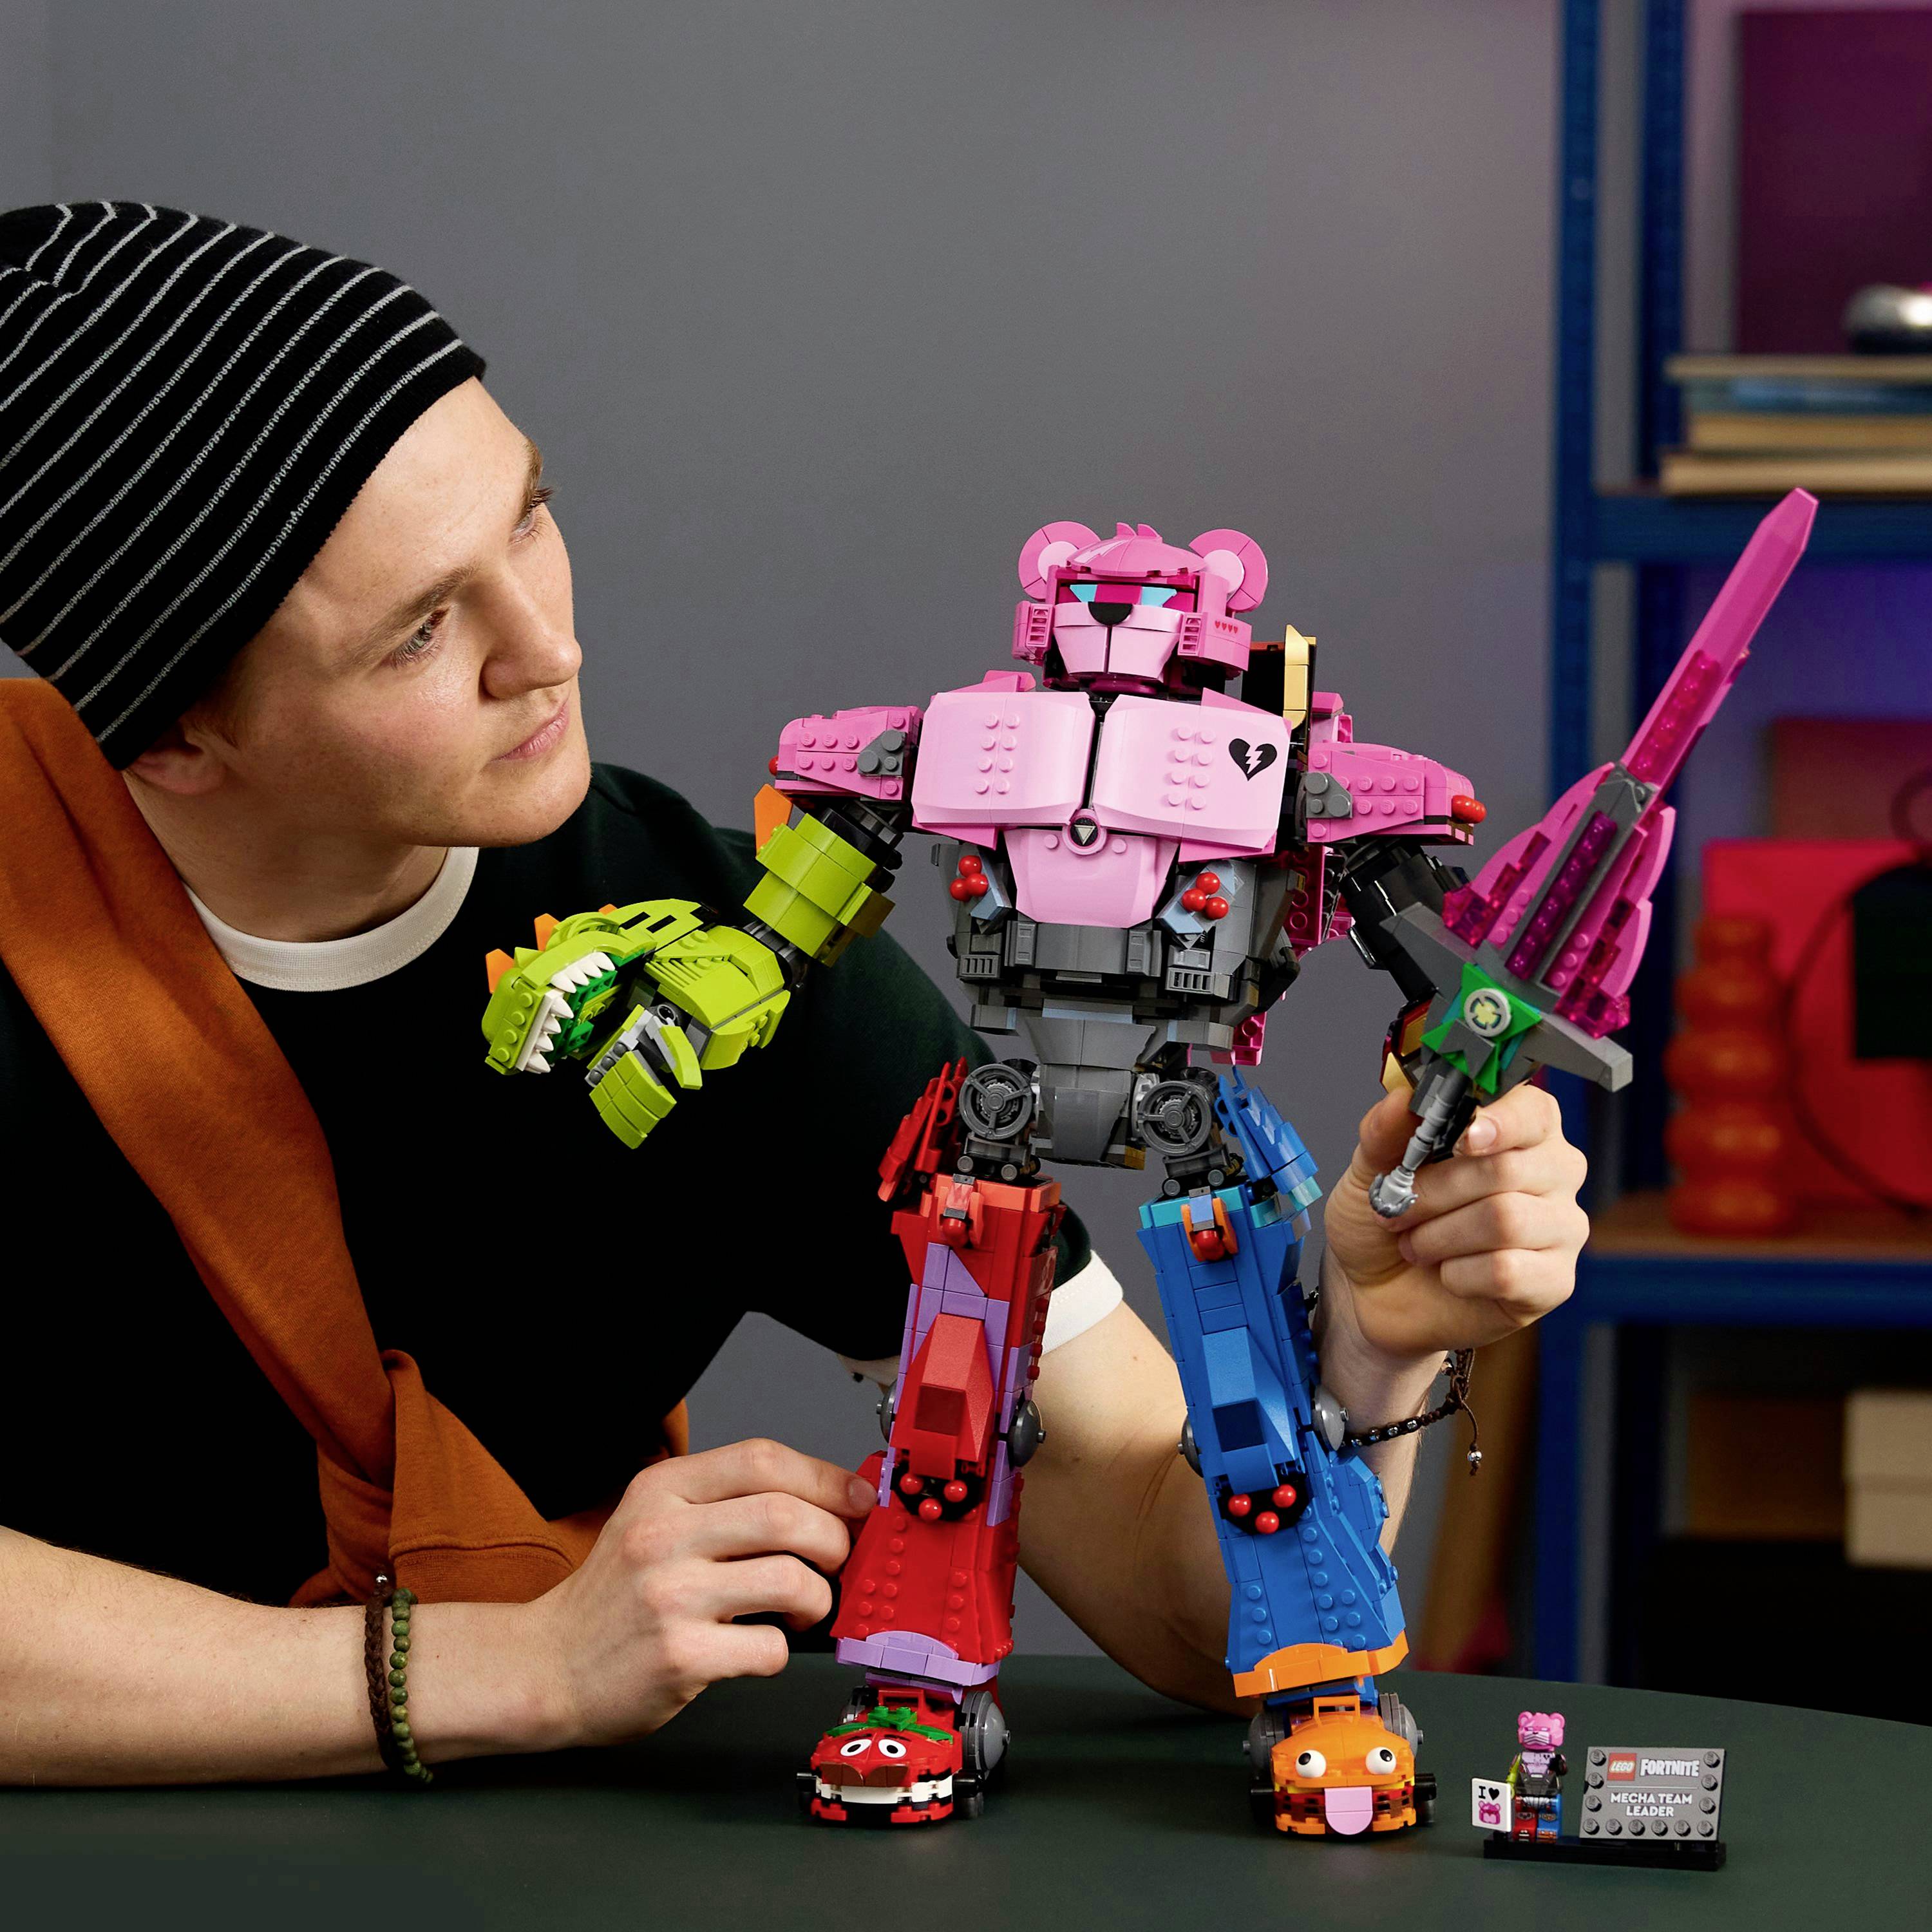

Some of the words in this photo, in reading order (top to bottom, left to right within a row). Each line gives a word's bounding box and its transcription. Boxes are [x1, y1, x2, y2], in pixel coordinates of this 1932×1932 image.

[1610, 1761, 1635, 1772] LEGO
[1640, 1759, 1700, 1777] FORTNITE
[1478, 1785, 1486, 1799] I
[1611, 1792, 1656, 1803] MECHA
[1658, 1793, 1692, 1804] TEAM
[1625, 1805, 1674, 1817] LEADER
